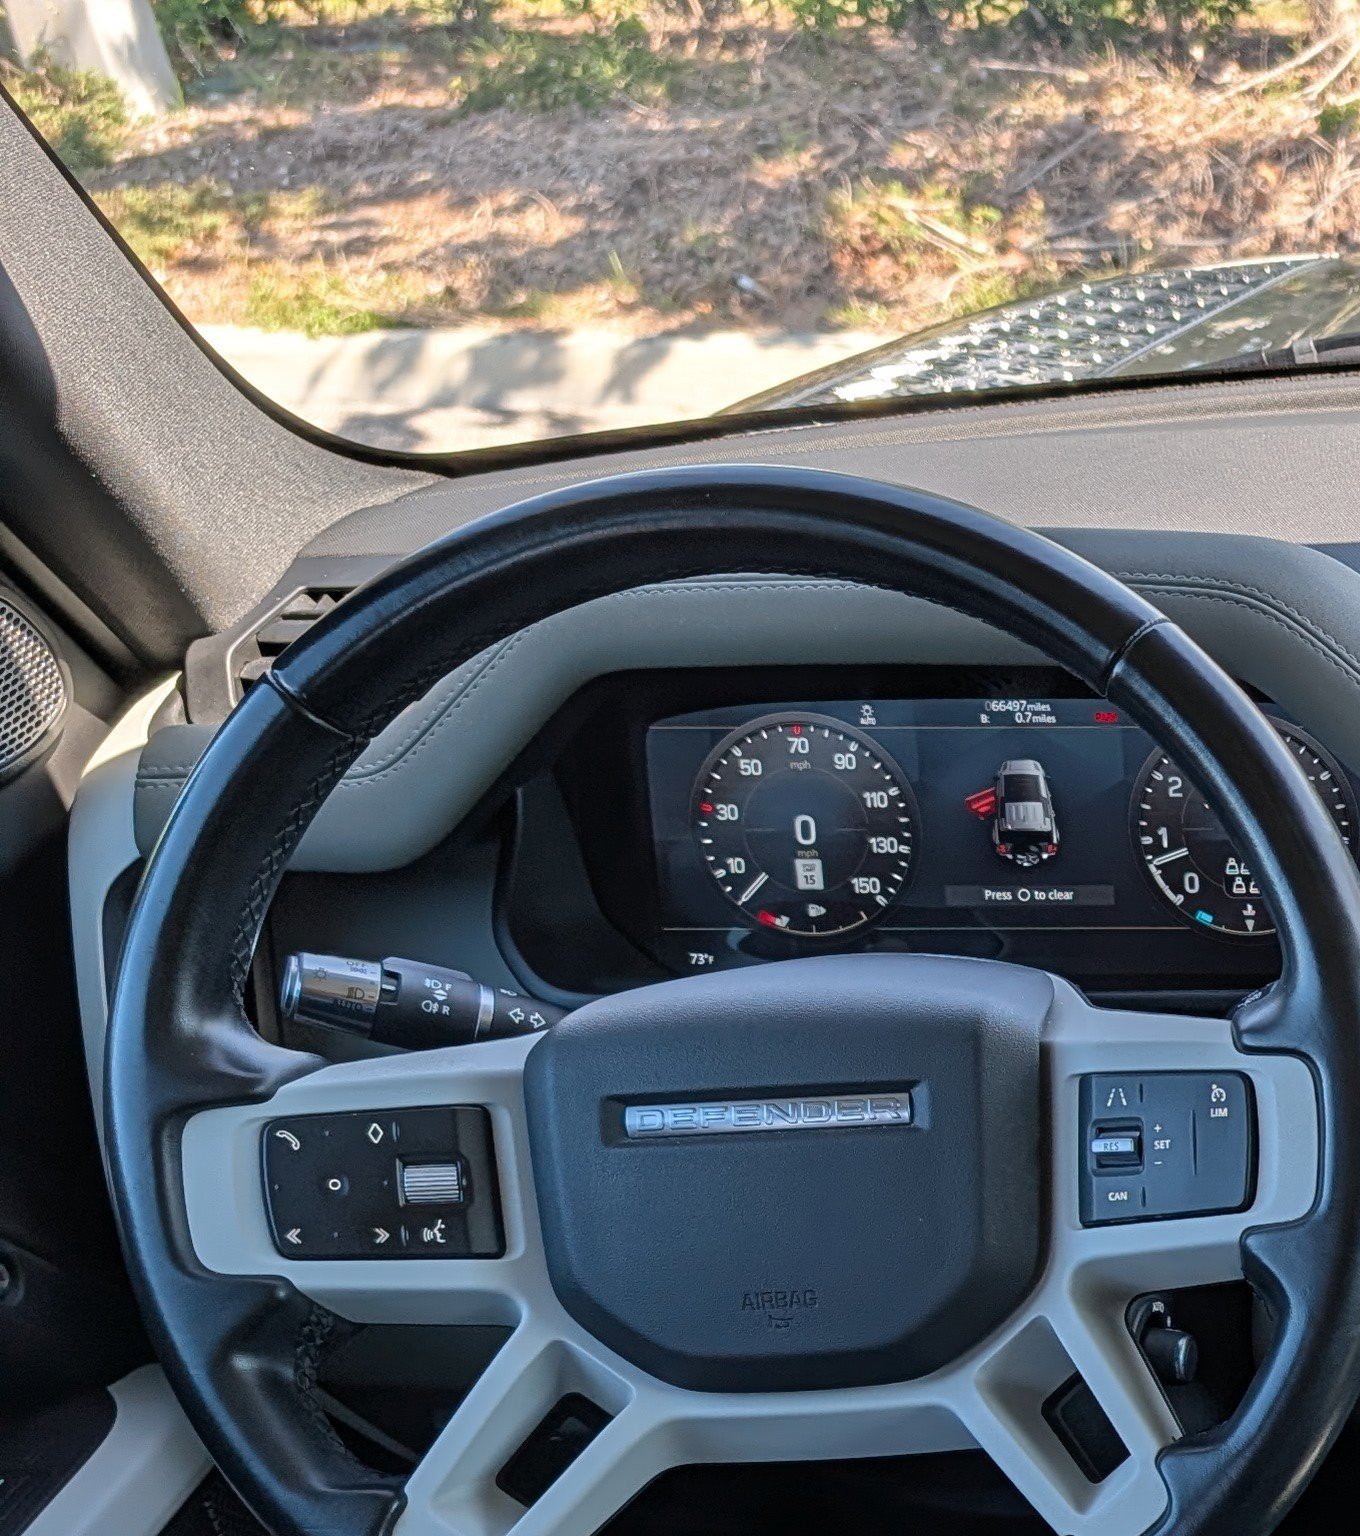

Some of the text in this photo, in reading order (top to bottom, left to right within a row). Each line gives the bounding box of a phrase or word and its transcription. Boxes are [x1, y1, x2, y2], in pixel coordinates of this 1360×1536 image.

[787, 737, 809, 754] 70
[739, 758, 762, 776] 50
[789, 760, 811, 771] mph
[833, 753, 856, 770] 90
[1168, 776, 1183, 798] 2
[863, 791, 888, 808] 110
[716, 804, 738, 821] 30
[793, 814, 816, 845] 0
[1156, 827, 1168, 848] 1
[797, 849, 819, 859] mph
[868, 837, 898, 855] 130
[725, 857, 746, 874] 10
[803, 874, 816, 886] 15
[851, 877, 881, 894] 150
[1183, 872, 1200, 894] 0
[984, 889, 1074, 900] Press to clear
[442, 1005, 451, 1016] R
[635, 1097, 902, 1132] DEFENDER
[1210, 1108, 1228, 1117] LIM
[1103, 1141, 1119, 1151] RES
[1154, 1140, 1171, 1150] SET
[1108, 1191, 1128, 1201] CAN
[741, 1288, 818, 1310] AIRBAG
